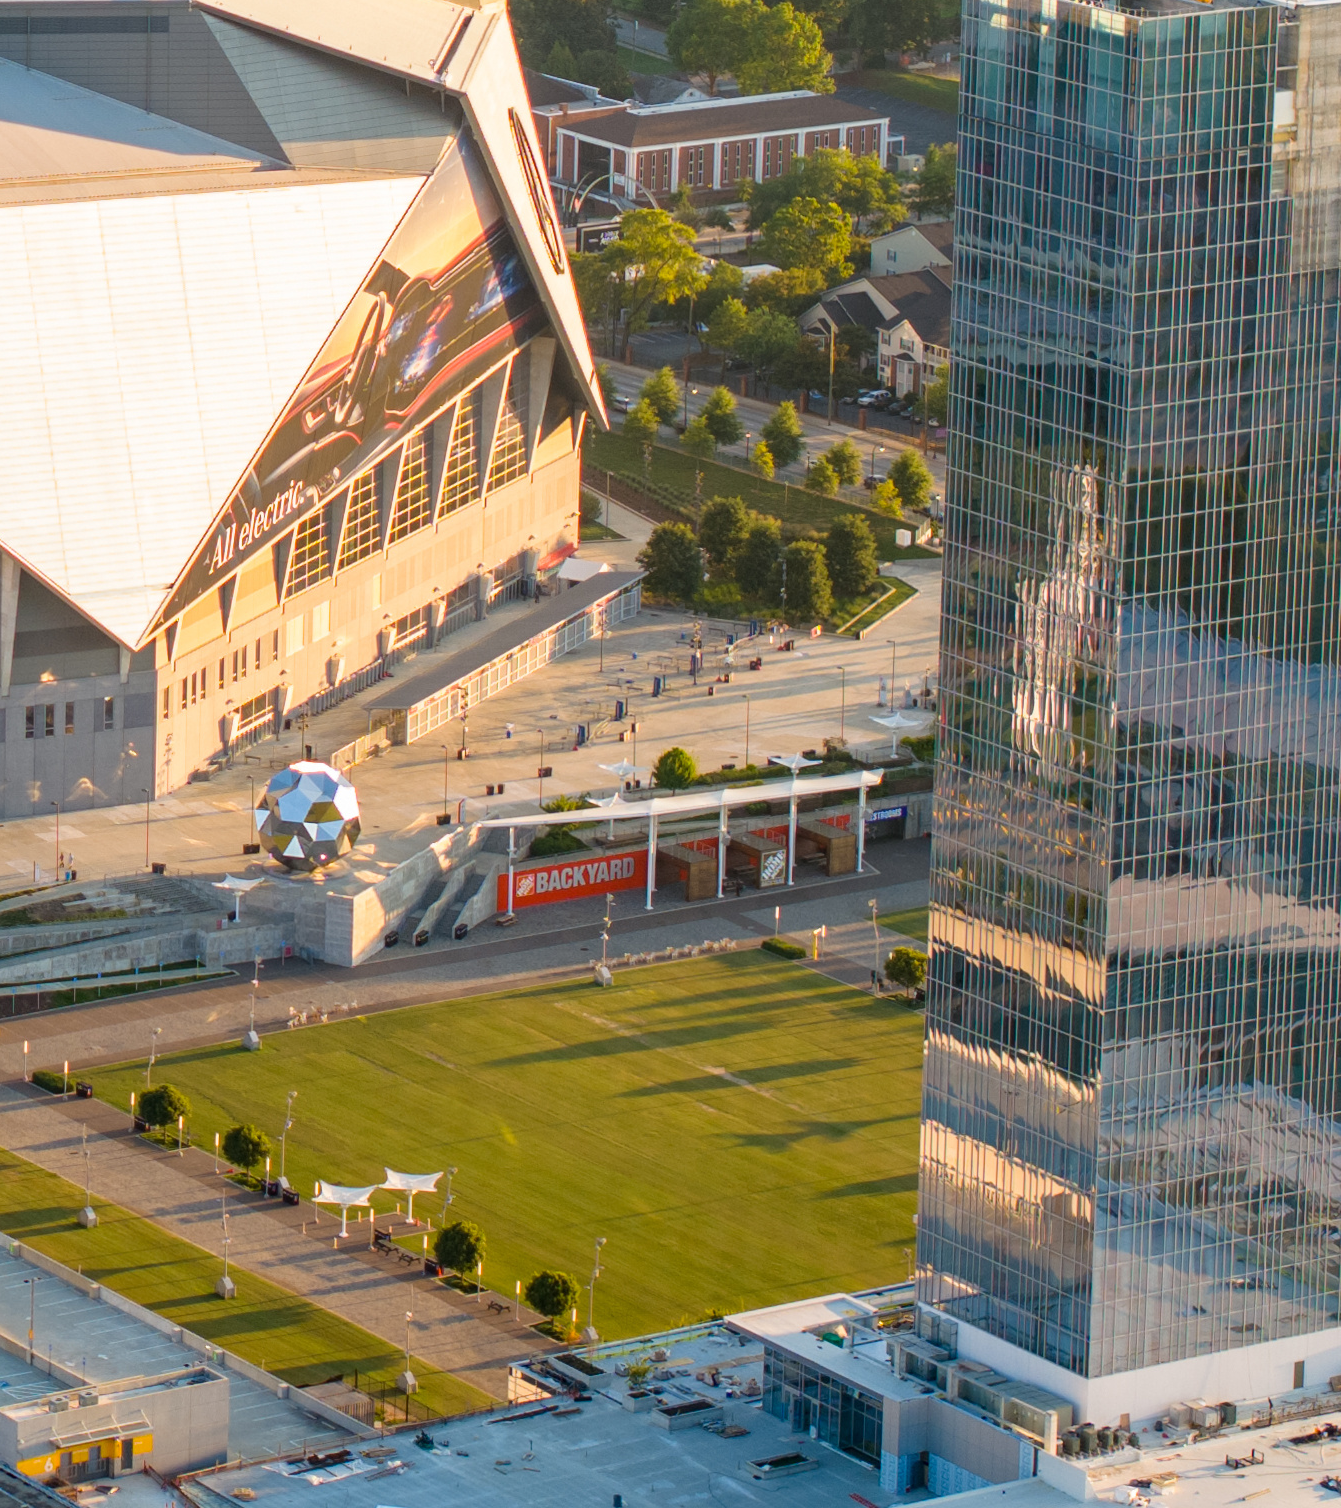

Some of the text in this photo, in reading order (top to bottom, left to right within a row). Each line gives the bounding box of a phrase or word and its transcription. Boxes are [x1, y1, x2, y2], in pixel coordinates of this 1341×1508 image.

[208, 479, 305, 575] All electric.
[536, 857, 635, 894] BACKYARD
[44, 1456, 53, 1472] 6
